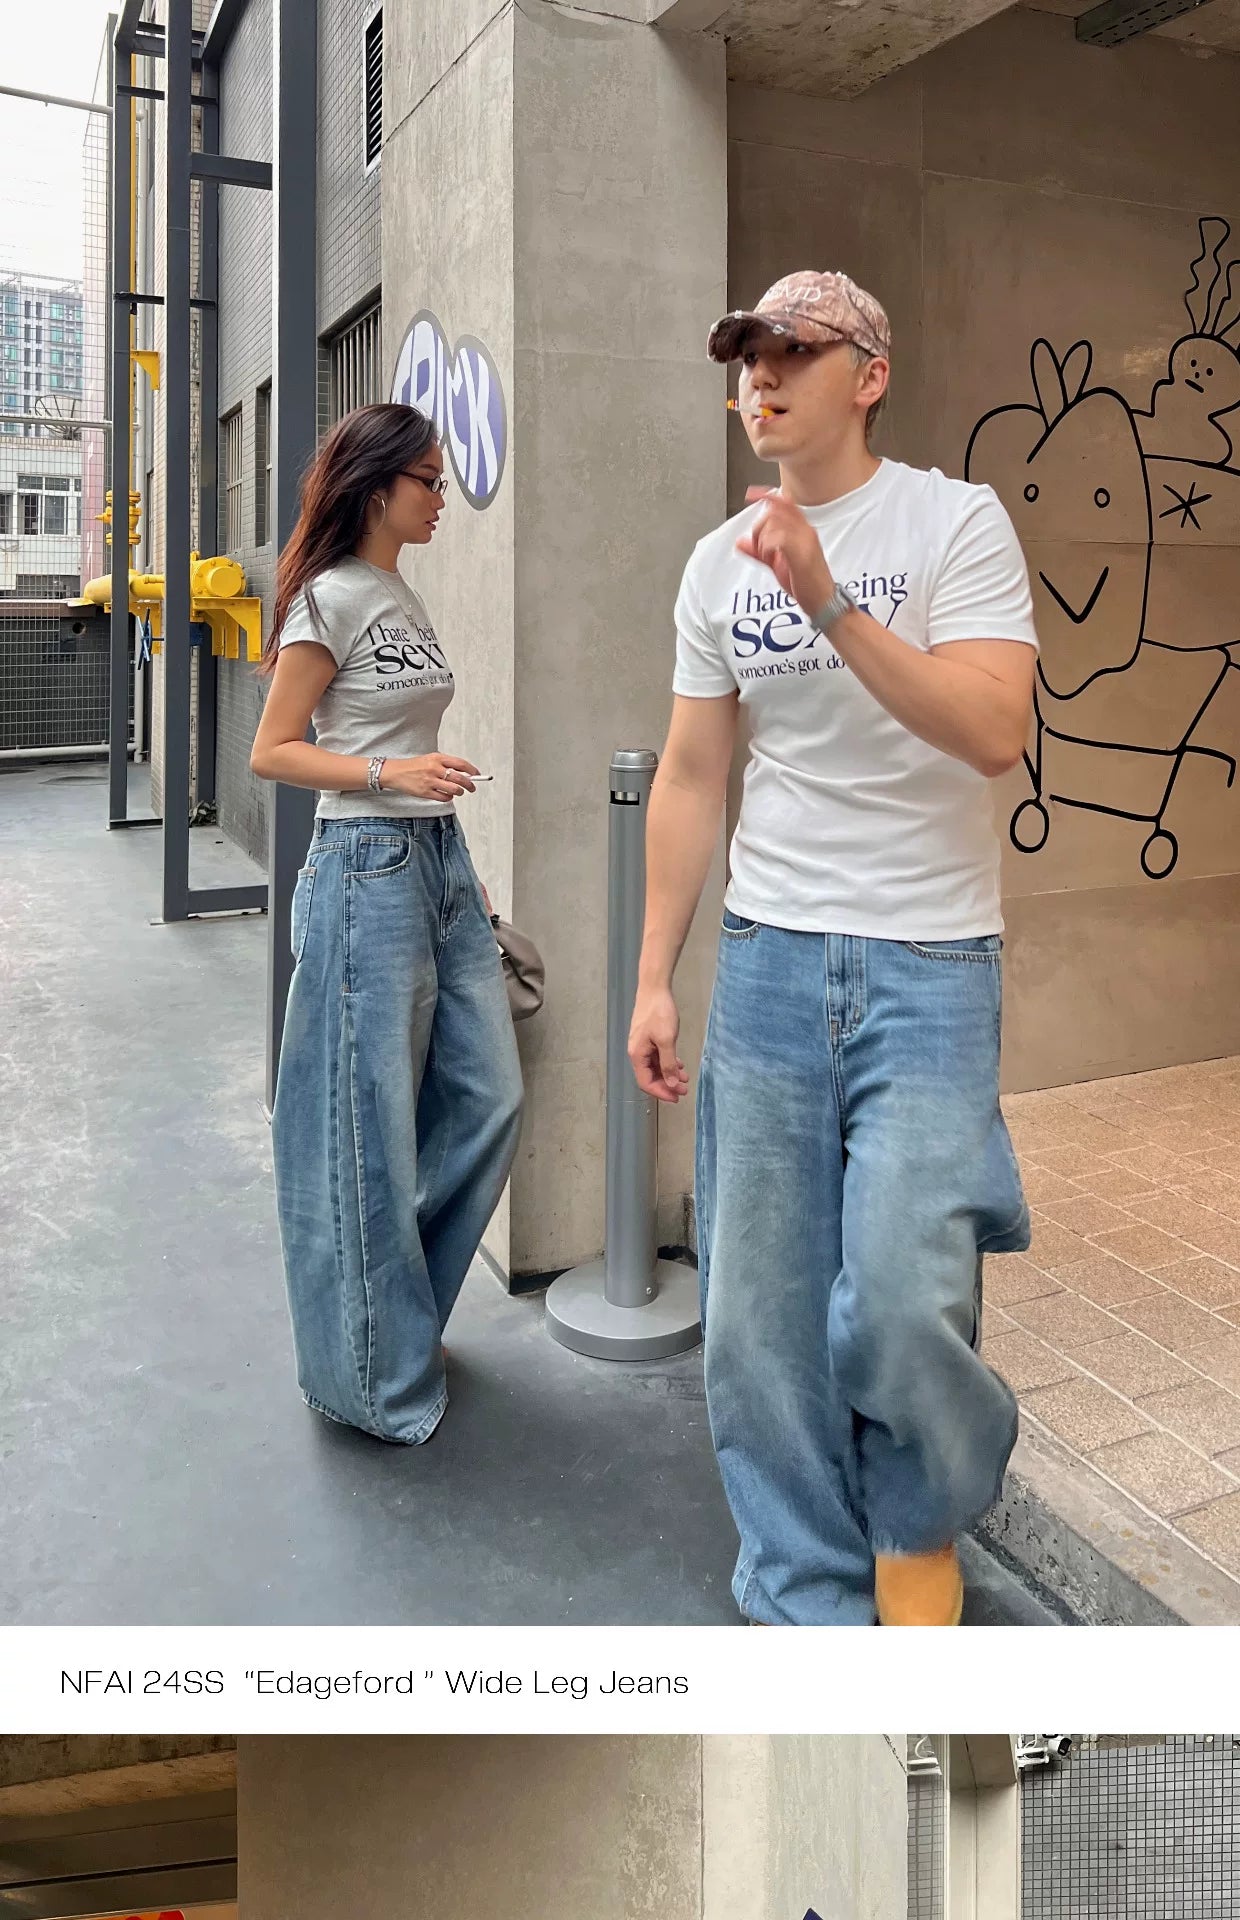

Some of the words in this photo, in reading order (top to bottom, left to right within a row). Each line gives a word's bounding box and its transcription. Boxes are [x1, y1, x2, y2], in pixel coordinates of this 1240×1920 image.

[732, 592, 739, 616] I
[844, 572, 909, 602] eing
[367, 626, 376, 646] I
[377, 624, 411, 643] hate
[737, 658, 796, 680] someone's
[798, 657, 821, 676] got
